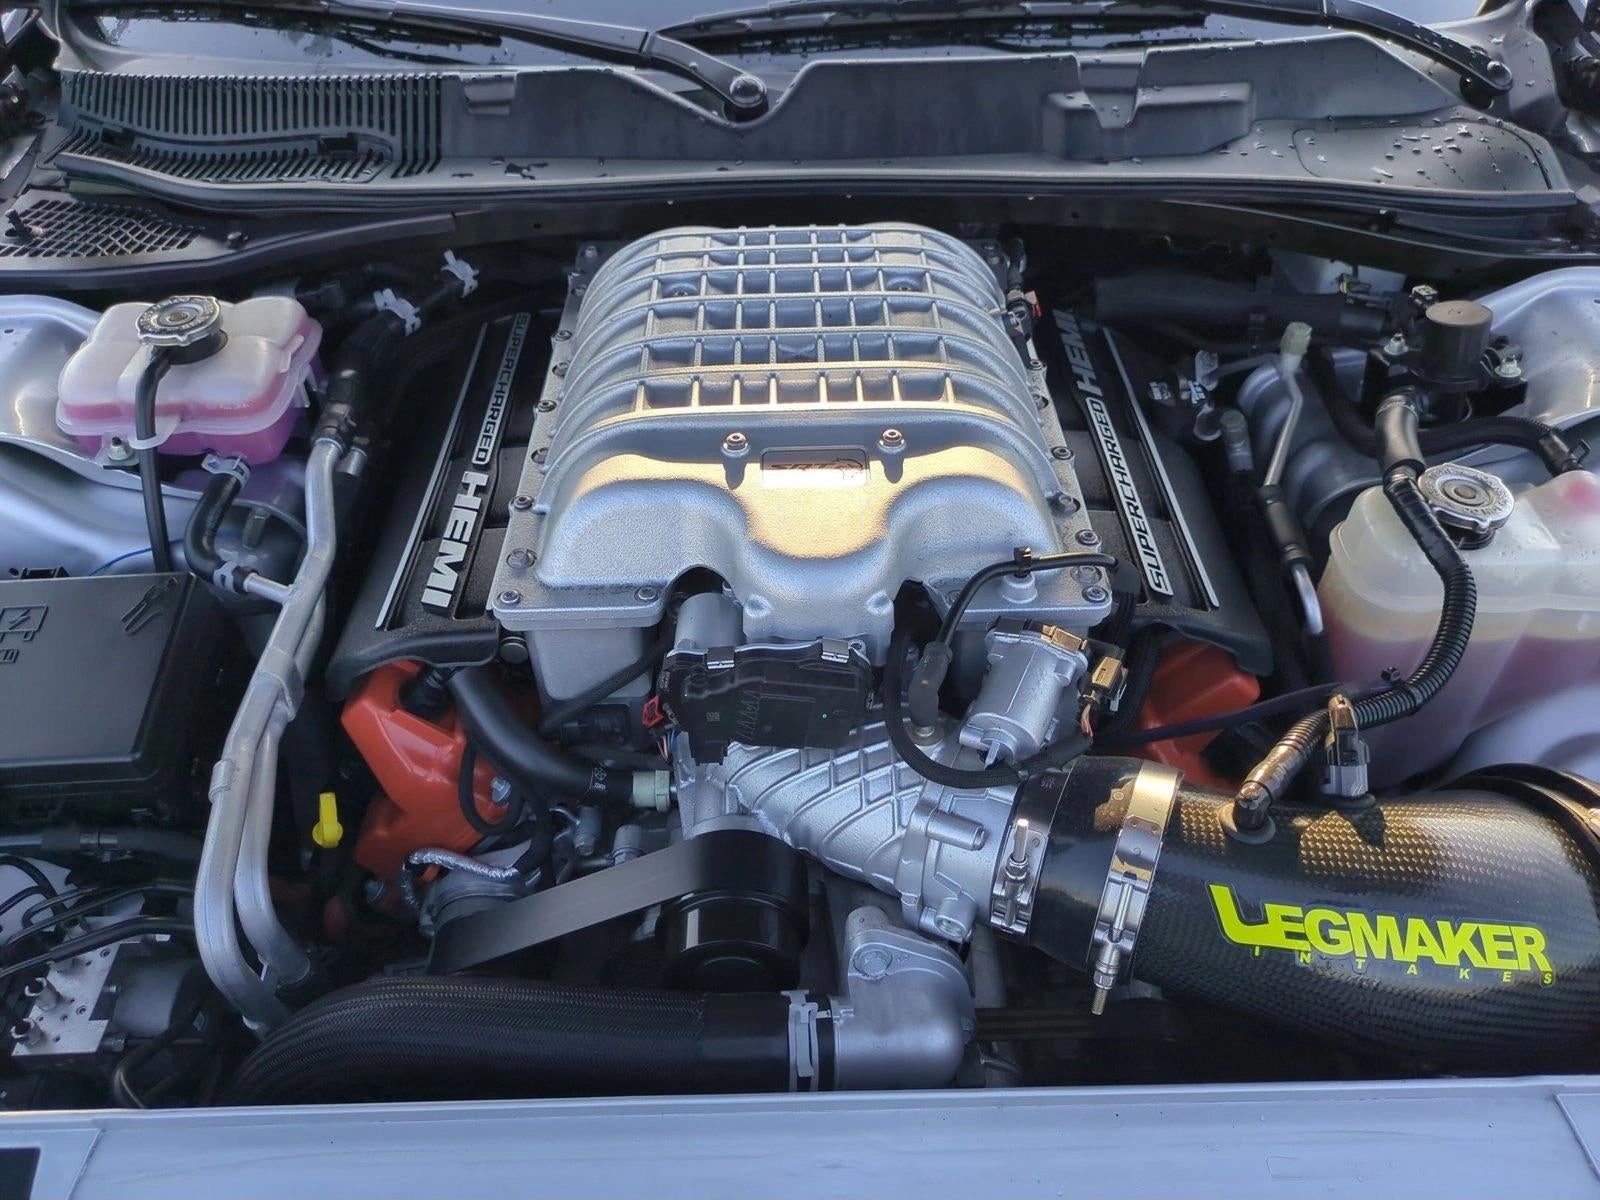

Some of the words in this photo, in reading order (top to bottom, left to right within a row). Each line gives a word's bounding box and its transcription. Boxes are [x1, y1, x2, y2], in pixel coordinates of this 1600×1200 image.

[474, 313, 529, 463] SUPERCHARGED
[1052, 309, 1103, 397] HEMI
[421, 471, 489, 608] HEMI
[1089, 400, 1168, 592] SUPERCHARGED
[1209, 884, 1552, 972] LEGMAKER
[1254, 946, 1554, 984] INTAKES
